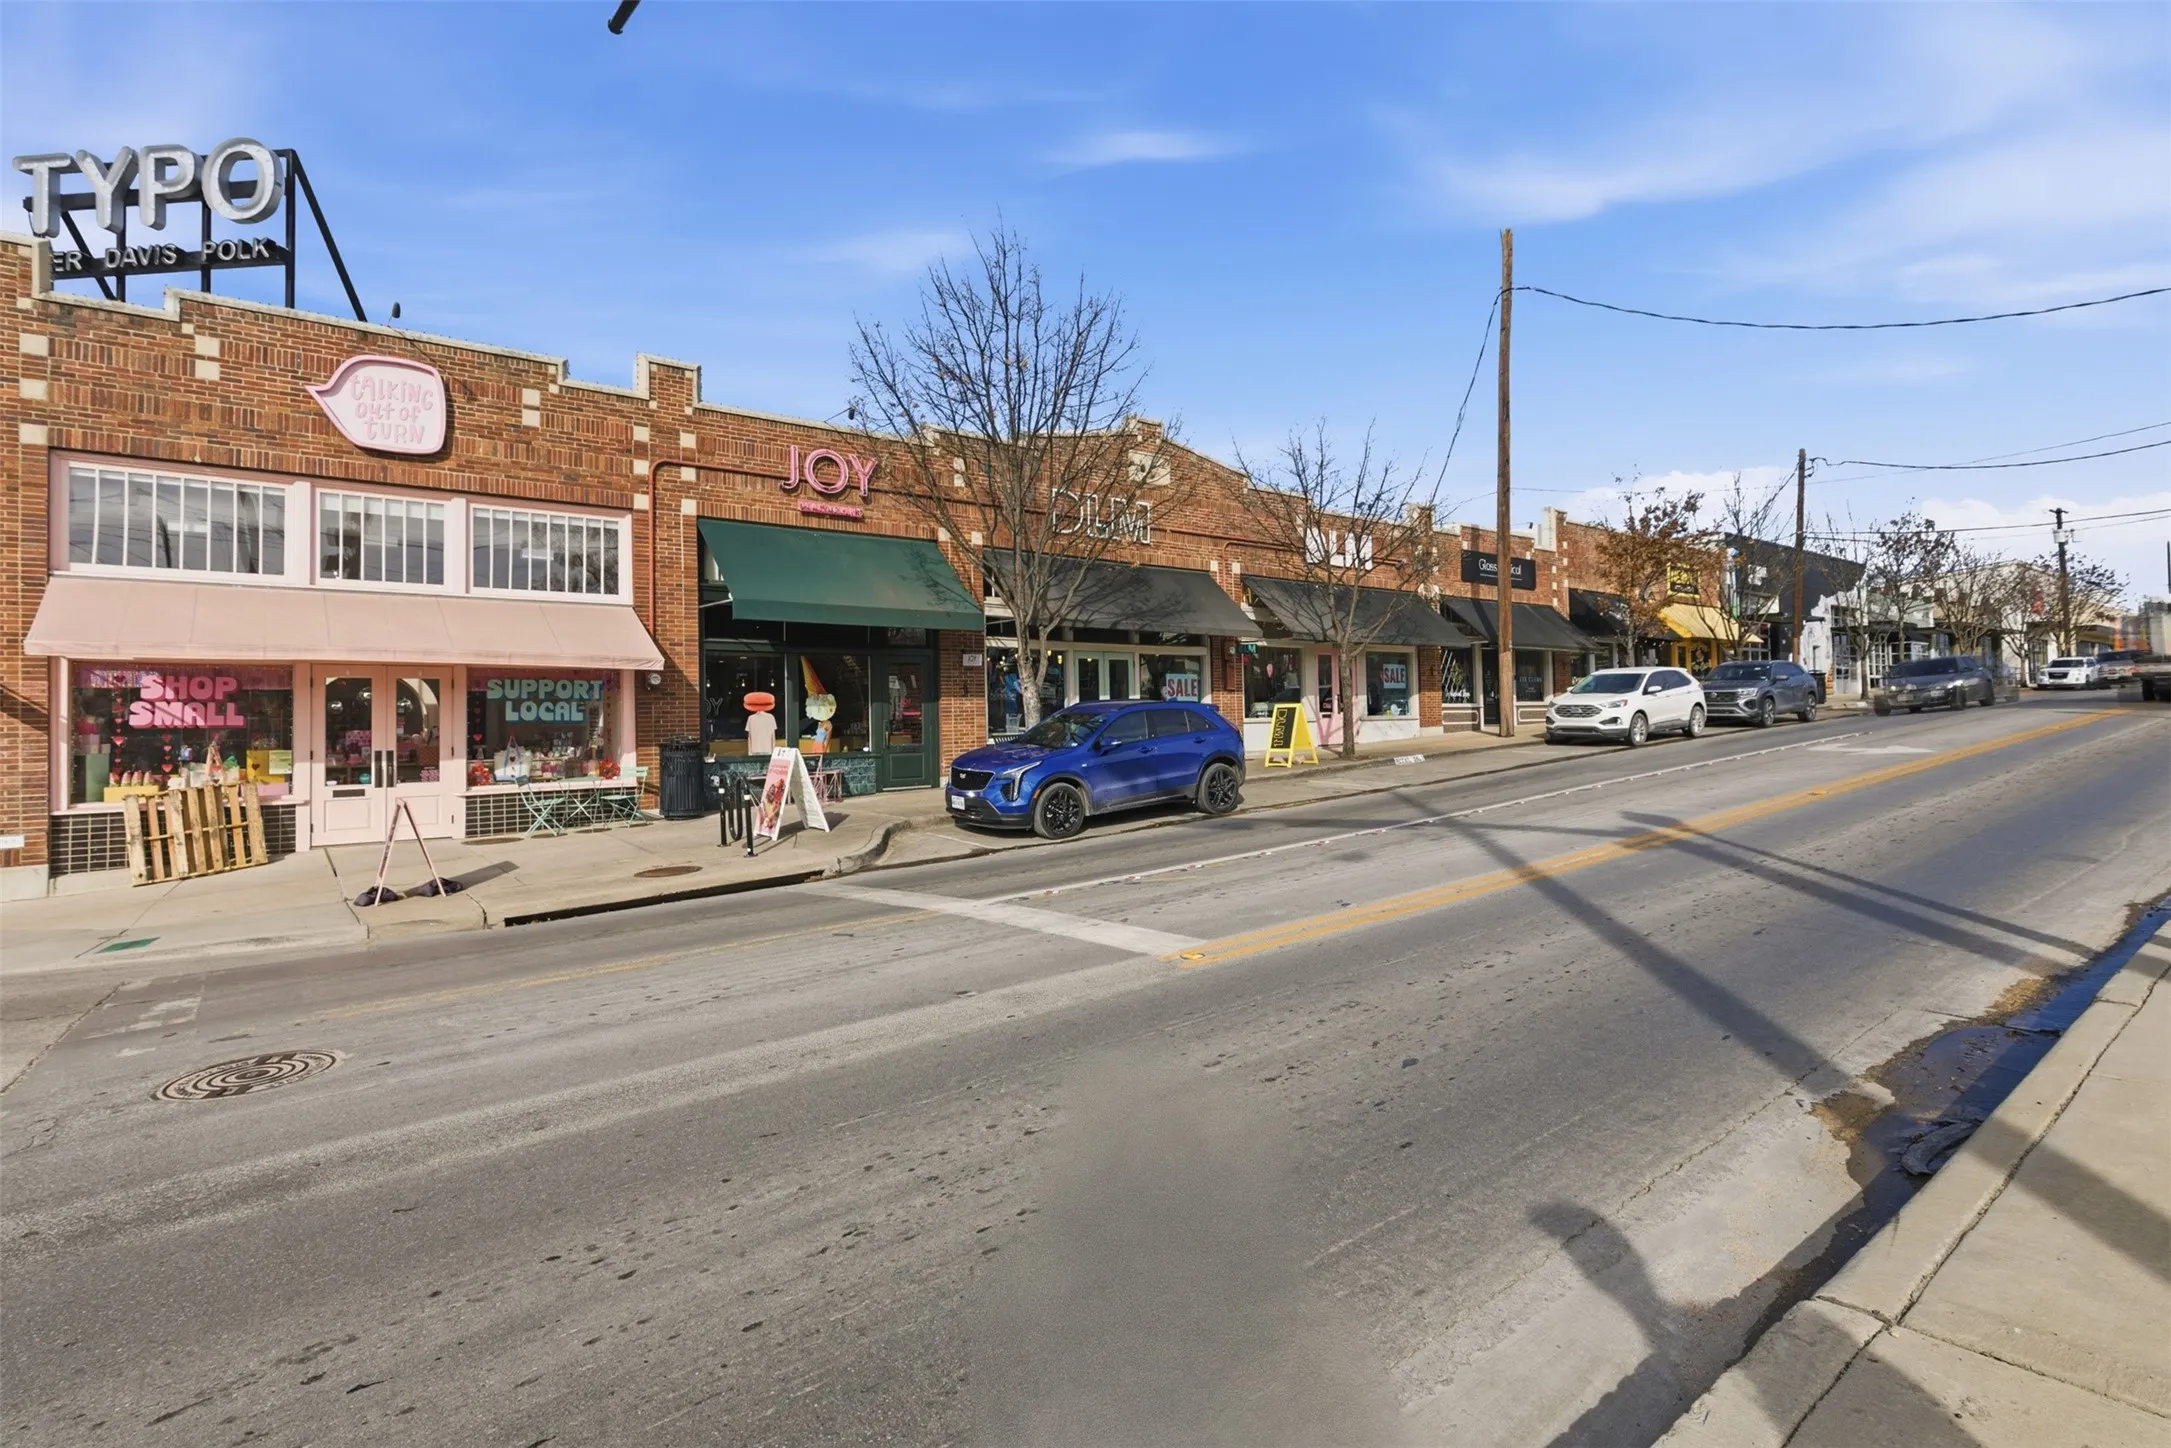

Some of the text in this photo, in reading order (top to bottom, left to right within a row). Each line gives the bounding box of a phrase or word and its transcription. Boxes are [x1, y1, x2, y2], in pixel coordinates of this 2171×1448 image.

[13, 137, 285, 238] TYPO
[104, 243, 178, 269] DAVIS
[200, 237, 269, 262] POLK
[780, 445, 878, 497] JOY
[1052, 488, 1152, 544] DLM
[140, 674, 239, 700] SHOP
[1167, 678, 1197, 697] SALE
[1383, 667, 1406, 684] SALE
[486, 678, 604, 701] SUPPORT
[128, 701, 246, 727] SMALL
[505, 700, 586, 724] LOCAL
